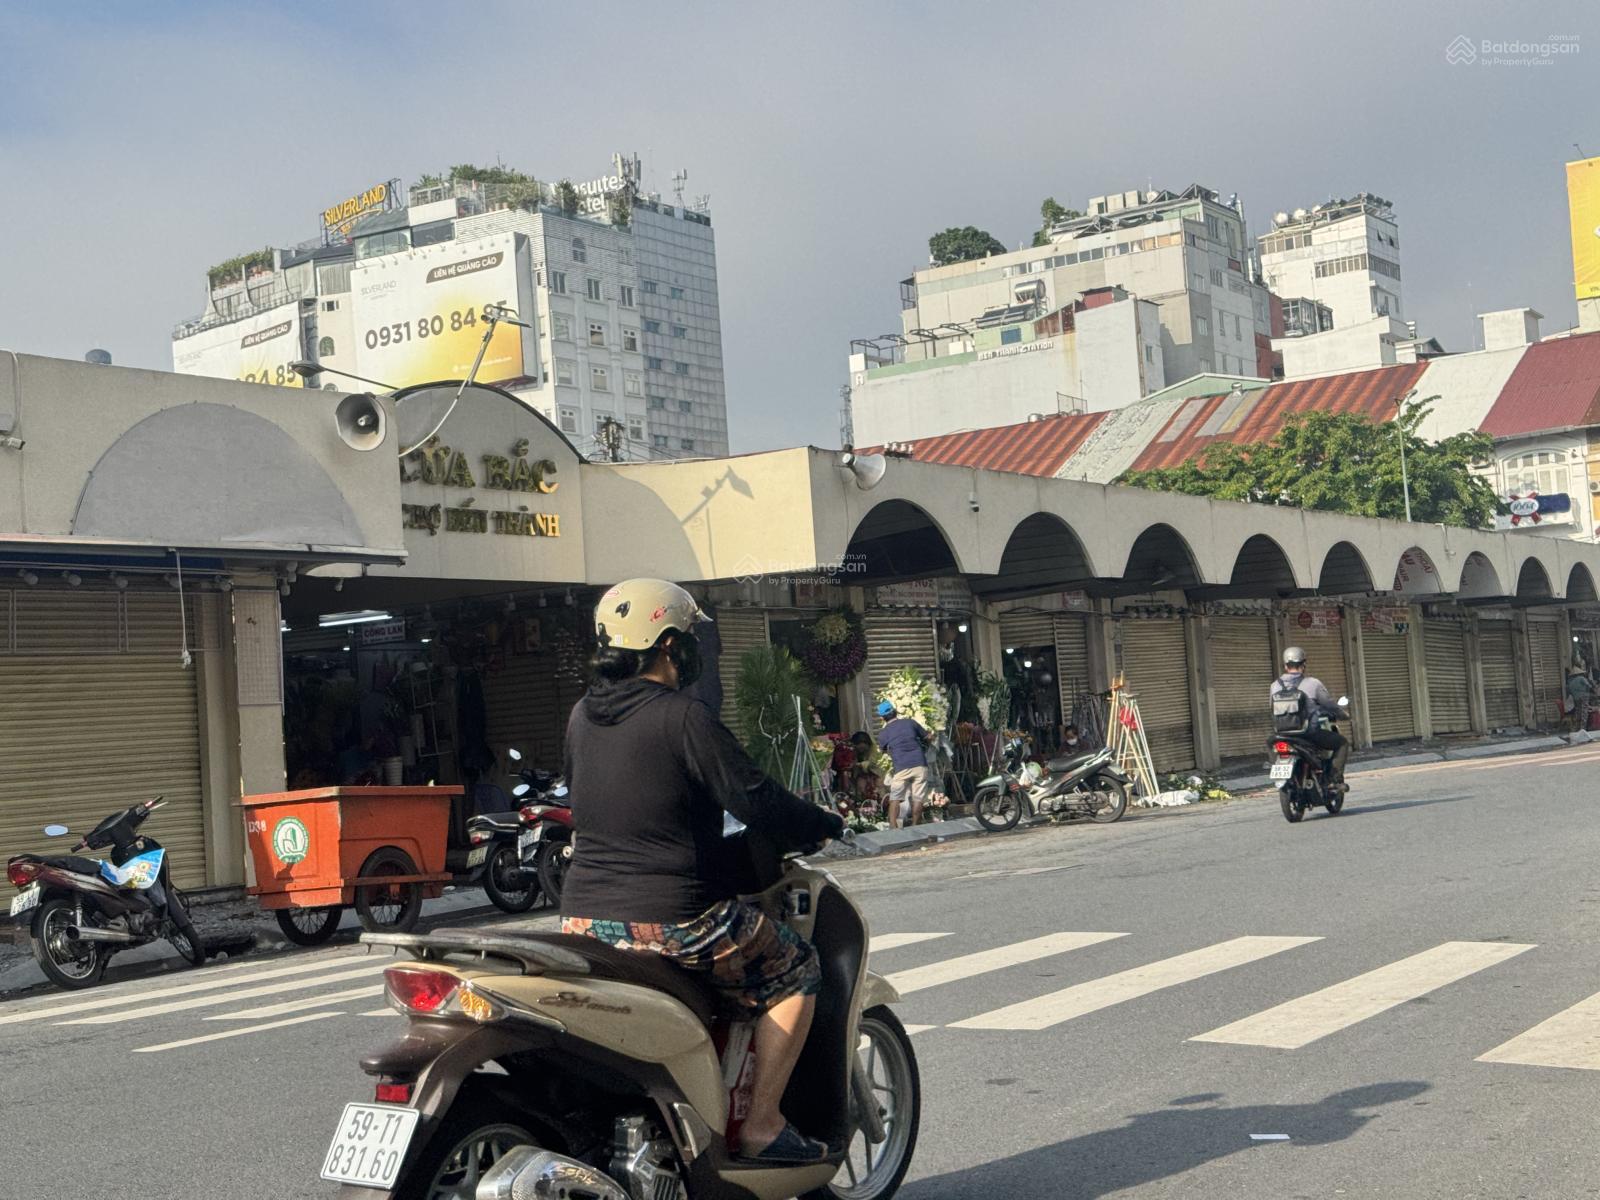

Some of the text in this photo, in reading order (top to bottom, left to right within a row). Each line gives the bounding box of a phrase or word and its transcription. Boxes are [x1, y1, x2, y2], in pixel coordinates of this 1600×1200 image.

[324, 184, 386, 227] SILVERLAND
[365, 321, 411, 350] 0931
[418, 315, 444, 339] 80
[450, 307, 477, 332] 84
[275, 361, 296, 385] 85
[329, 1144, 398, 1180] 831.60
